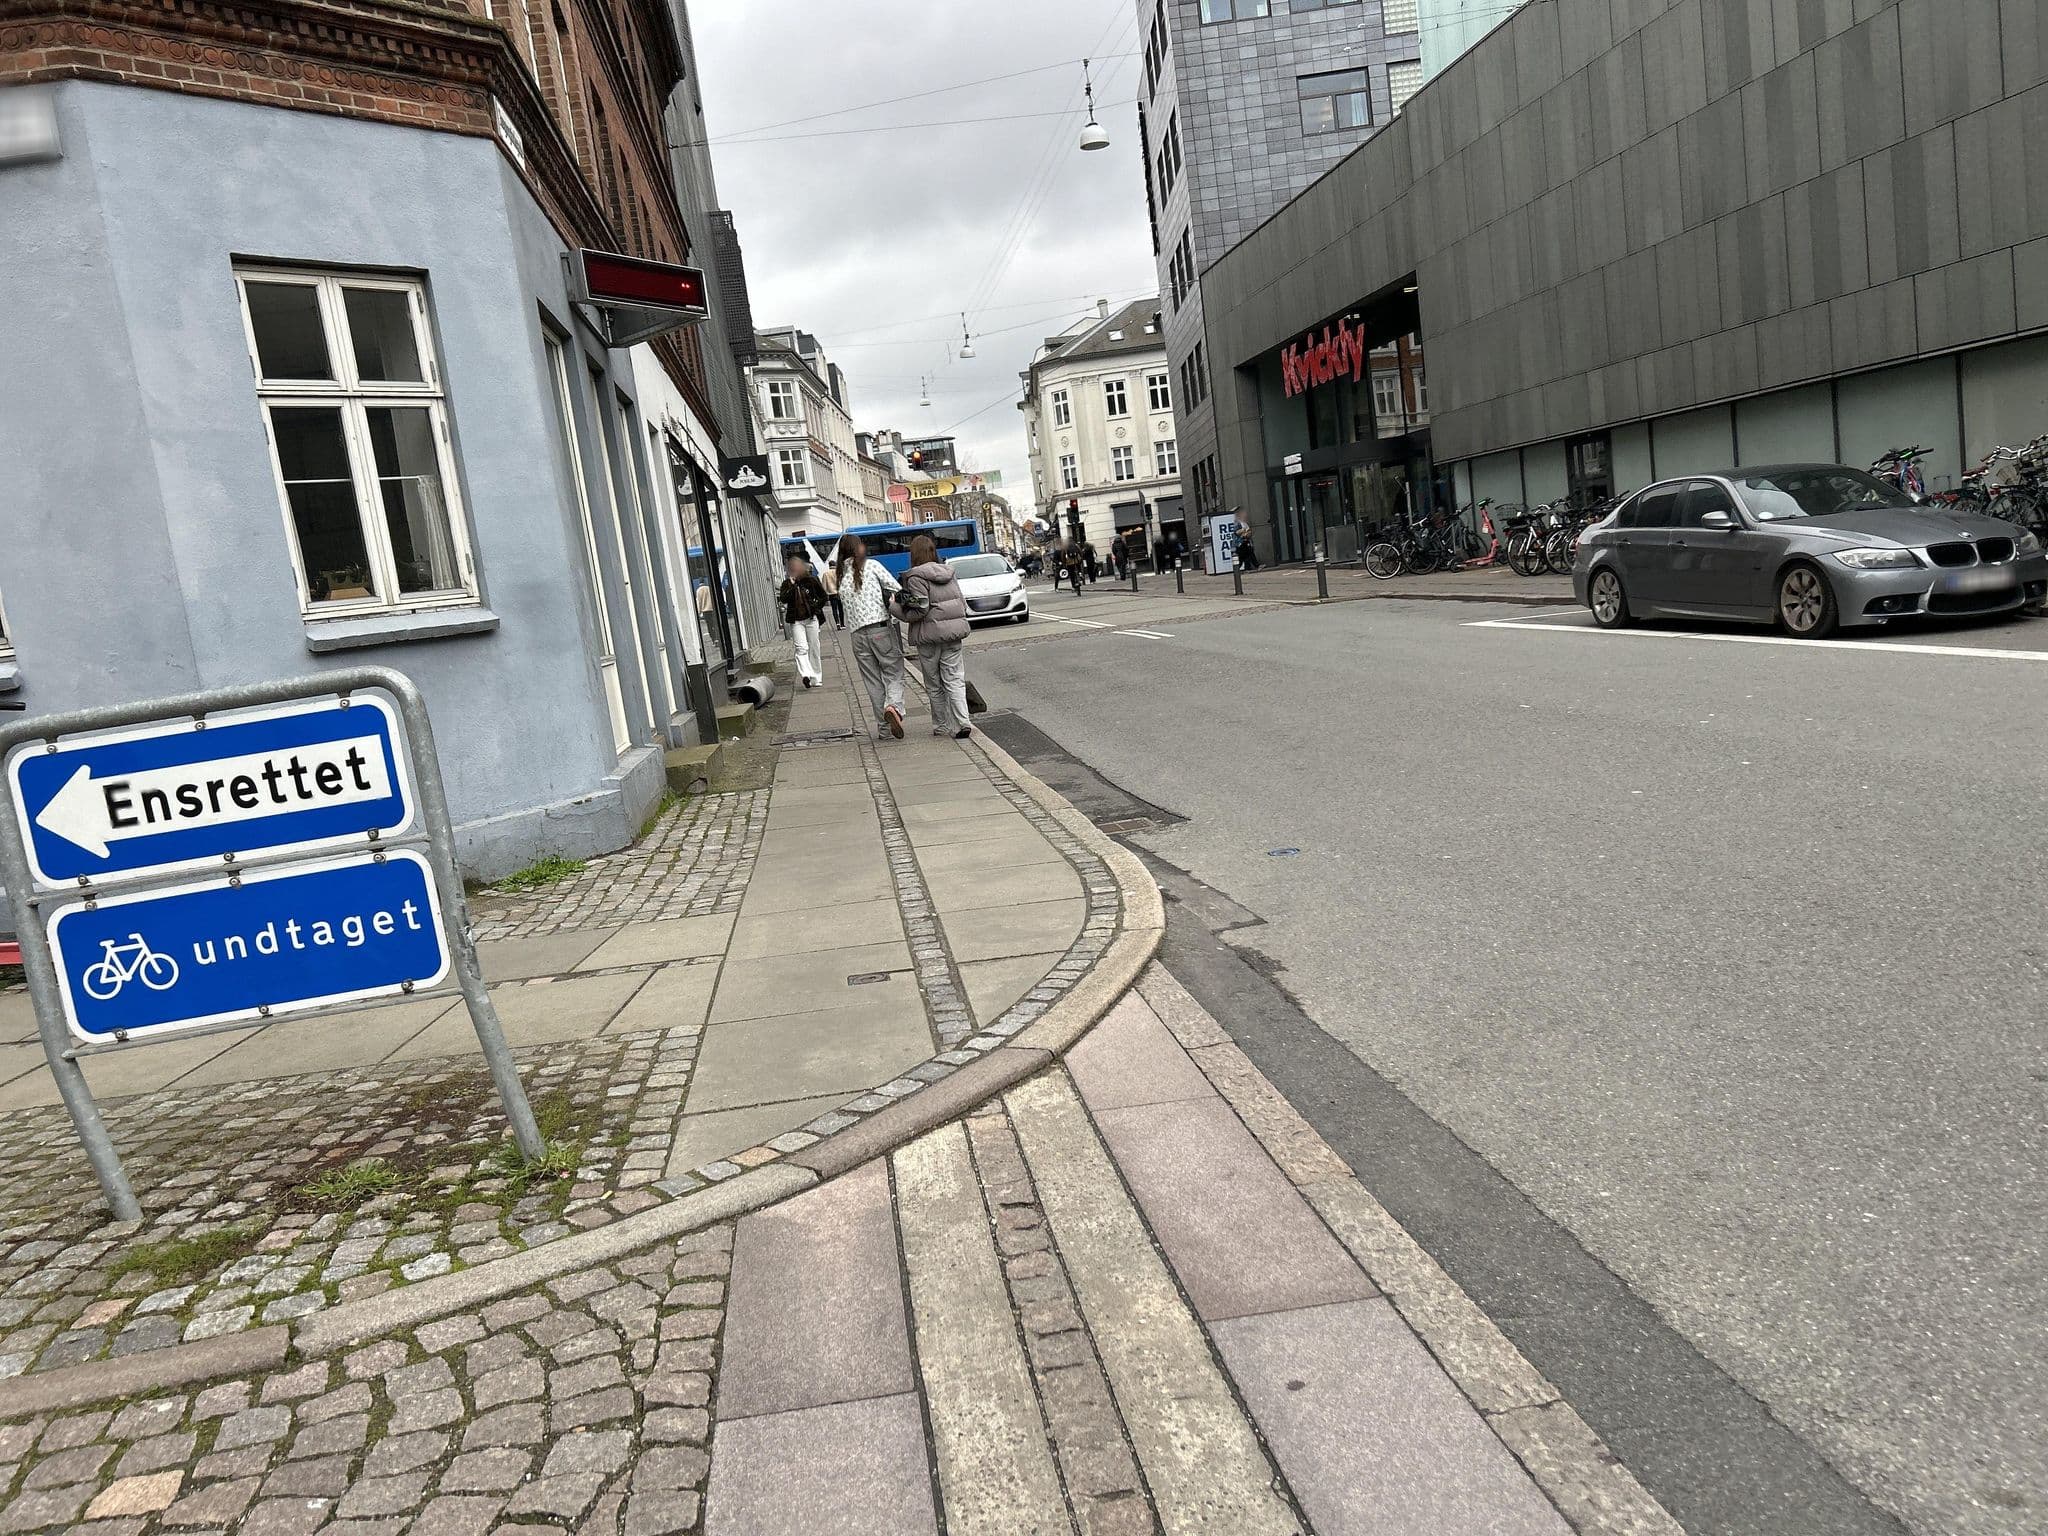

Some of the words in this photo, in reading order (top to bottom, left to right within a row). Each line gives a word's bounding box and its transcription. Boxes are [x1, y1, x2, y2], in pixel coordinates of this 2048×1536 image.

[1281, 319, 1365, 399] Kvickly
[103, 746, 372, 830] Ensrettet
[192, 899, 422, 967] undtaget
